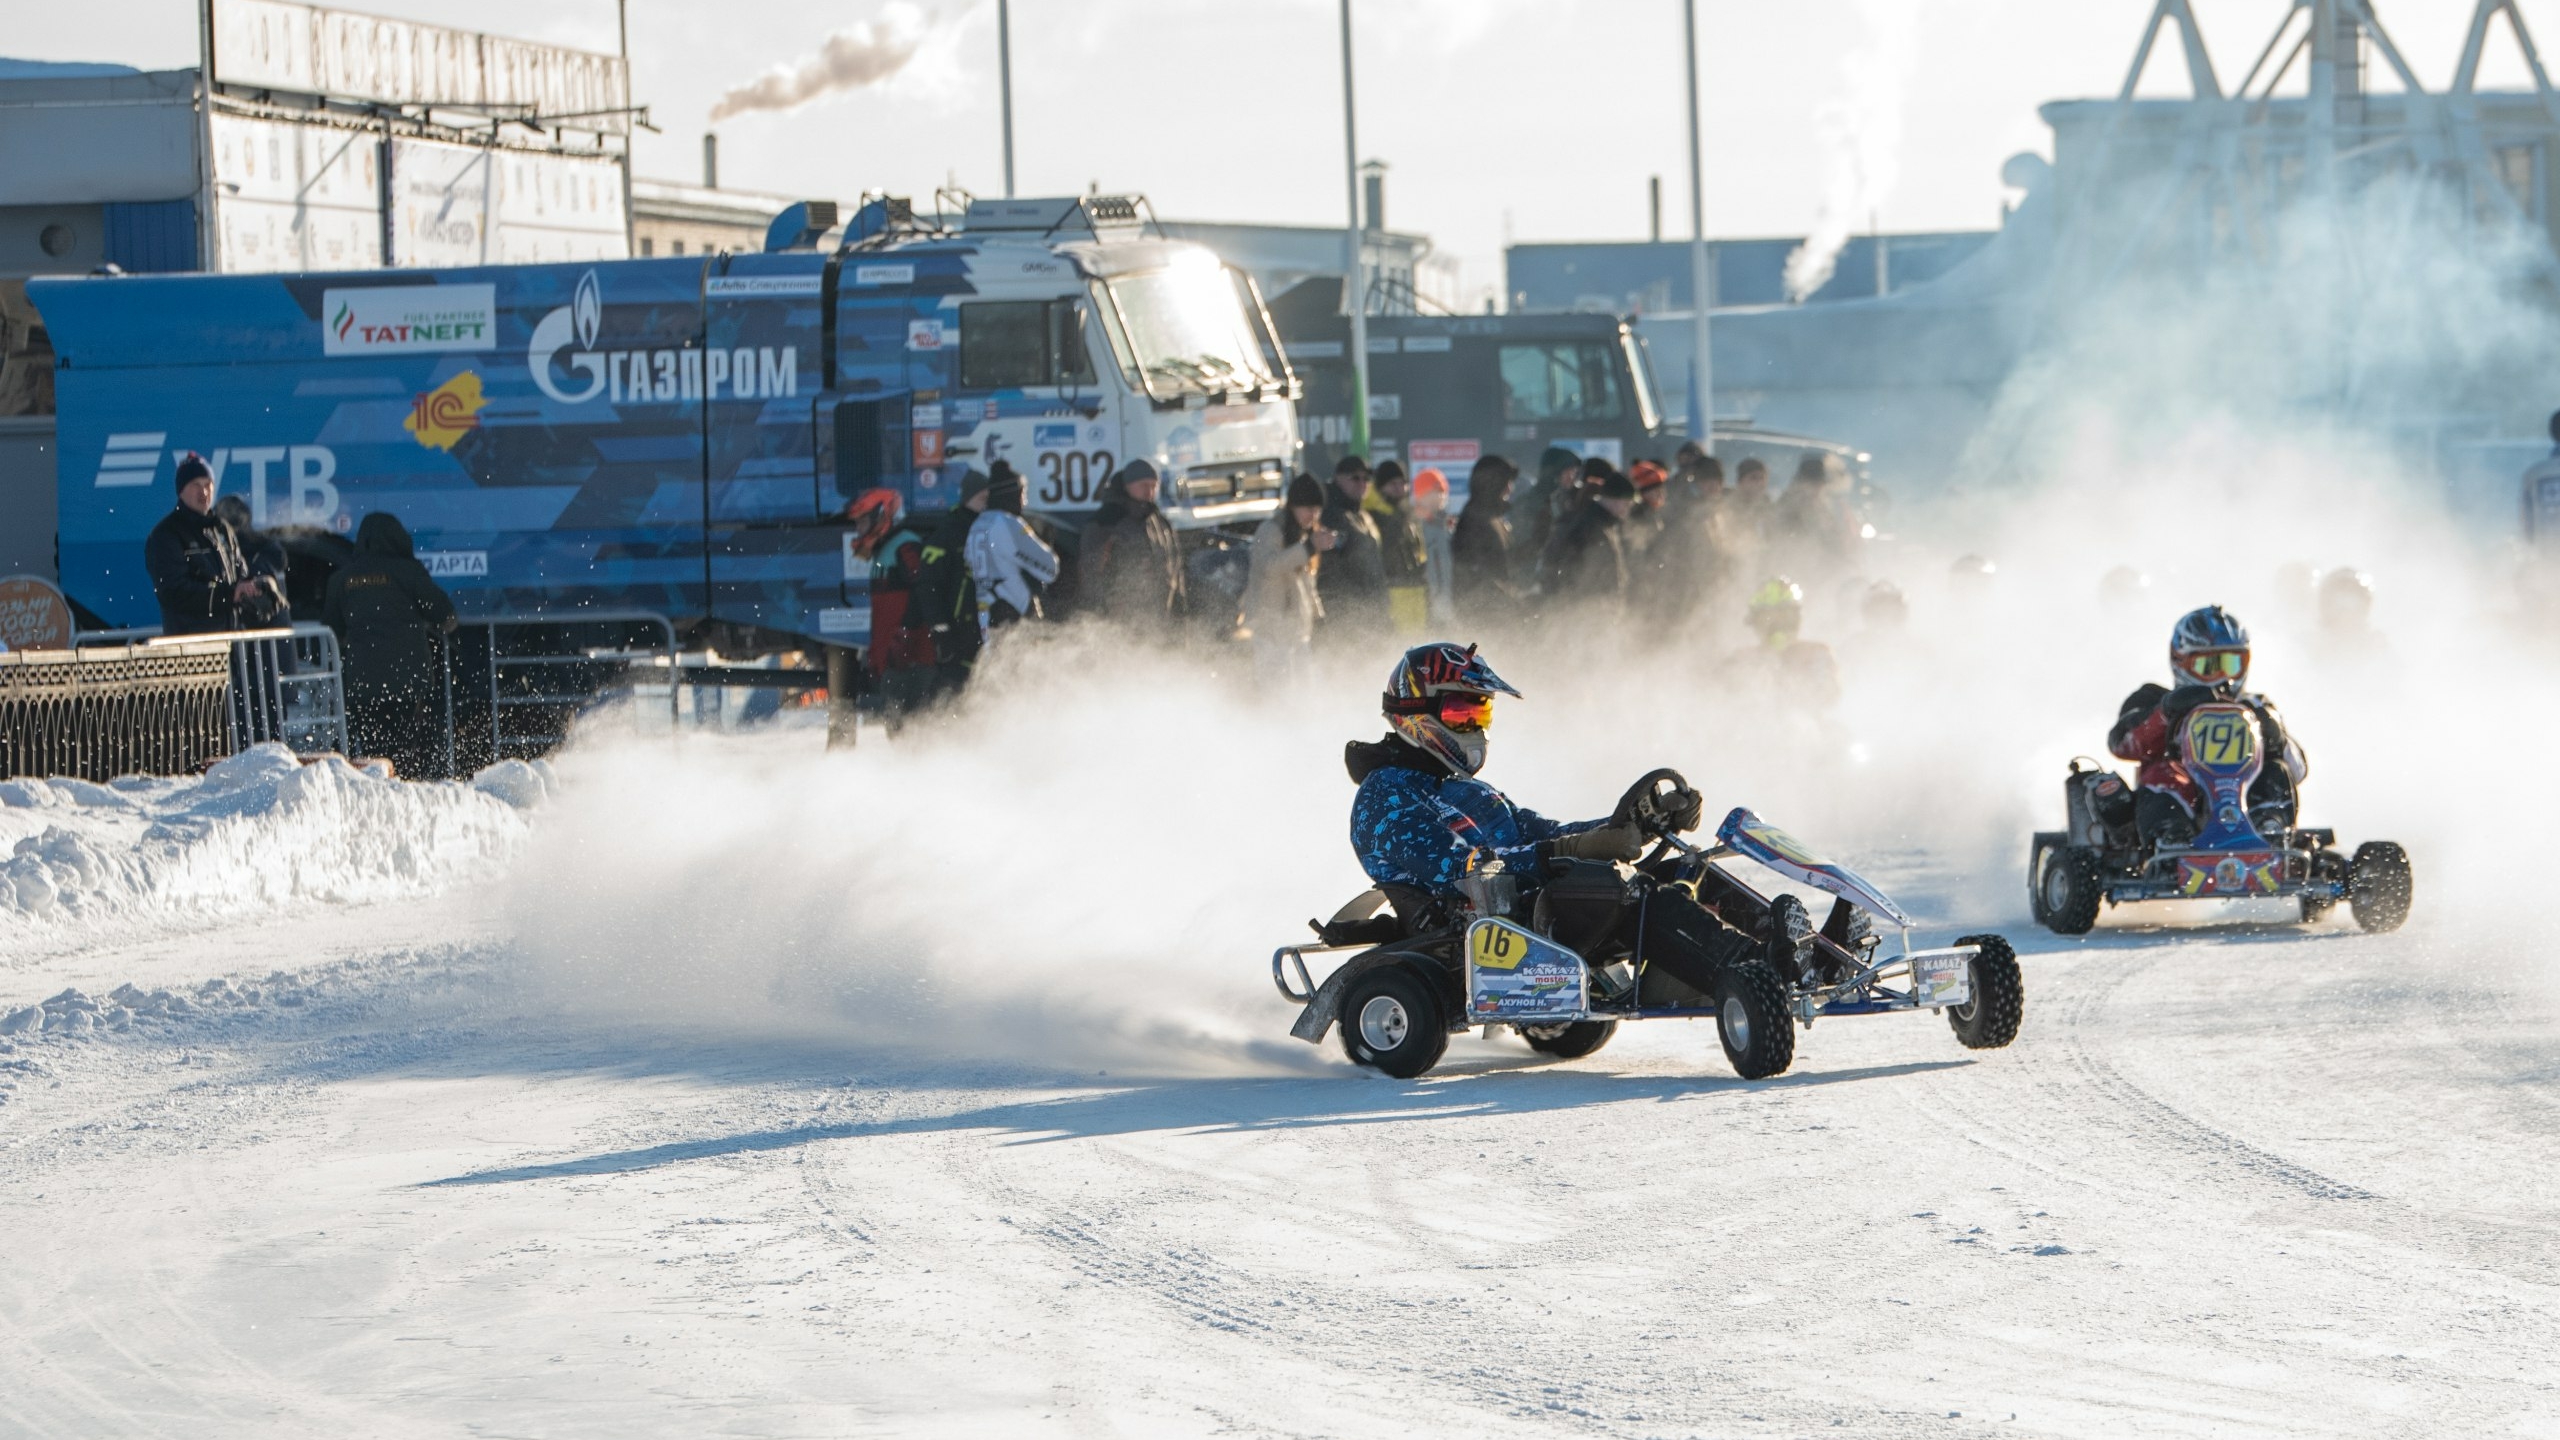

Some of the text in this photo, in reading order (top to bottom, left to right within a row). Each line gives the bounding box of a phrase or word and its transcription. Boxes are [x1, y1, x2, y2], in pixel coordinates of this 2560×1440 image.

[719, 277, 819, 294] Avito Спецтехника
[404, 311, 486, 322] FUEL PARTNER
[360, 322, 486, 344] TATNEFT
[609, 346, 797, 402] ГАЗПРОМ
[172, 446, 340, 526] VTB
[1039, 451, 1114, 503] 302
[2197, 724, 2247, 762] 191
[1483, 922, 1512, 958] 16
[1522, 965, 1578, 976] KAMAZ
[1924, 958, 1961, 971] KAMAZ
[1497, 998, 1547, 1008] АХУНОВ Н.
